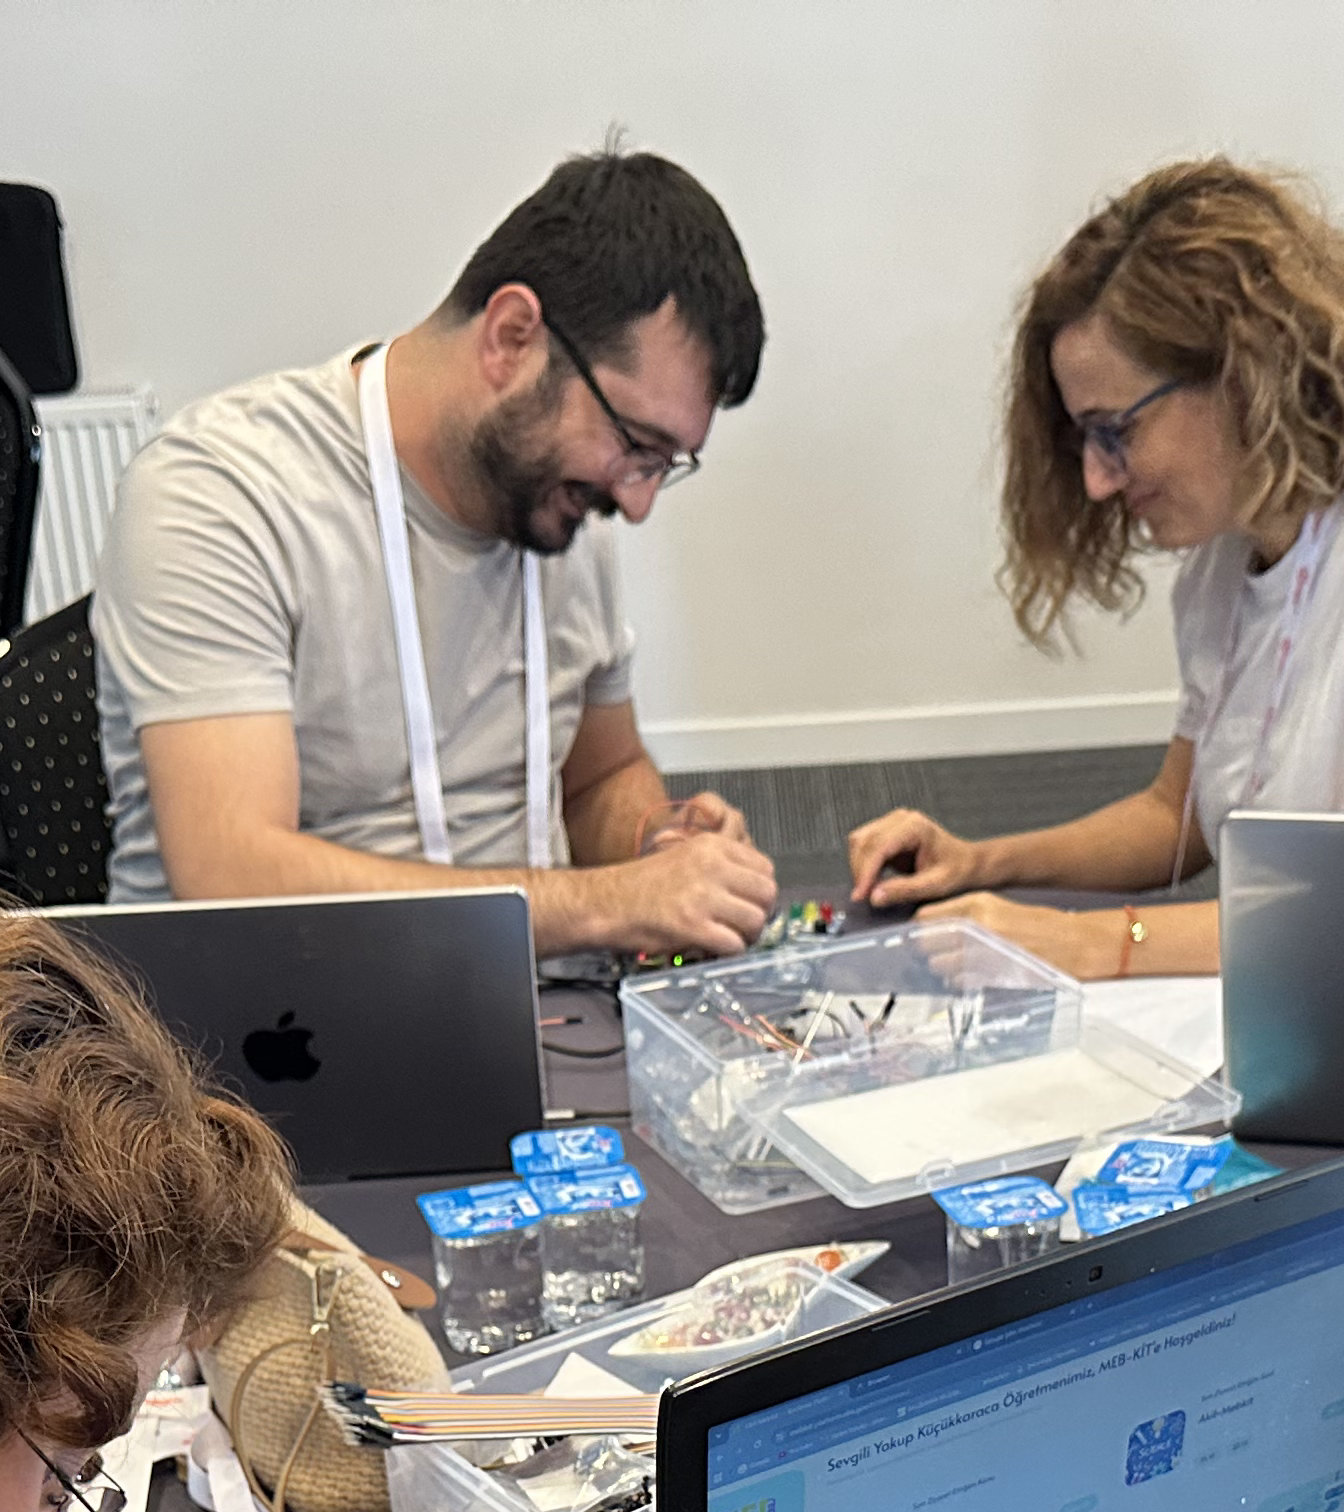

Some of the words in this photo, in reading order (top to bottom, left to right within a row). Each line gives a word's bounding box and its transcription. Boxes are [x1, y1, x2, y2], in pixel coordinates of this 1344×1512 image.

[827, 1446, 871, 1472] Sevgili
[873, 1433, 914, 1455] Yakup
[917, 1401, 1000, 1440] Küçükkaraca
[1003, 1367, 1096, 1408] Öğretmenimiz,
[1163, 1313, 1237, 1351] Hoşgeldiniz!
